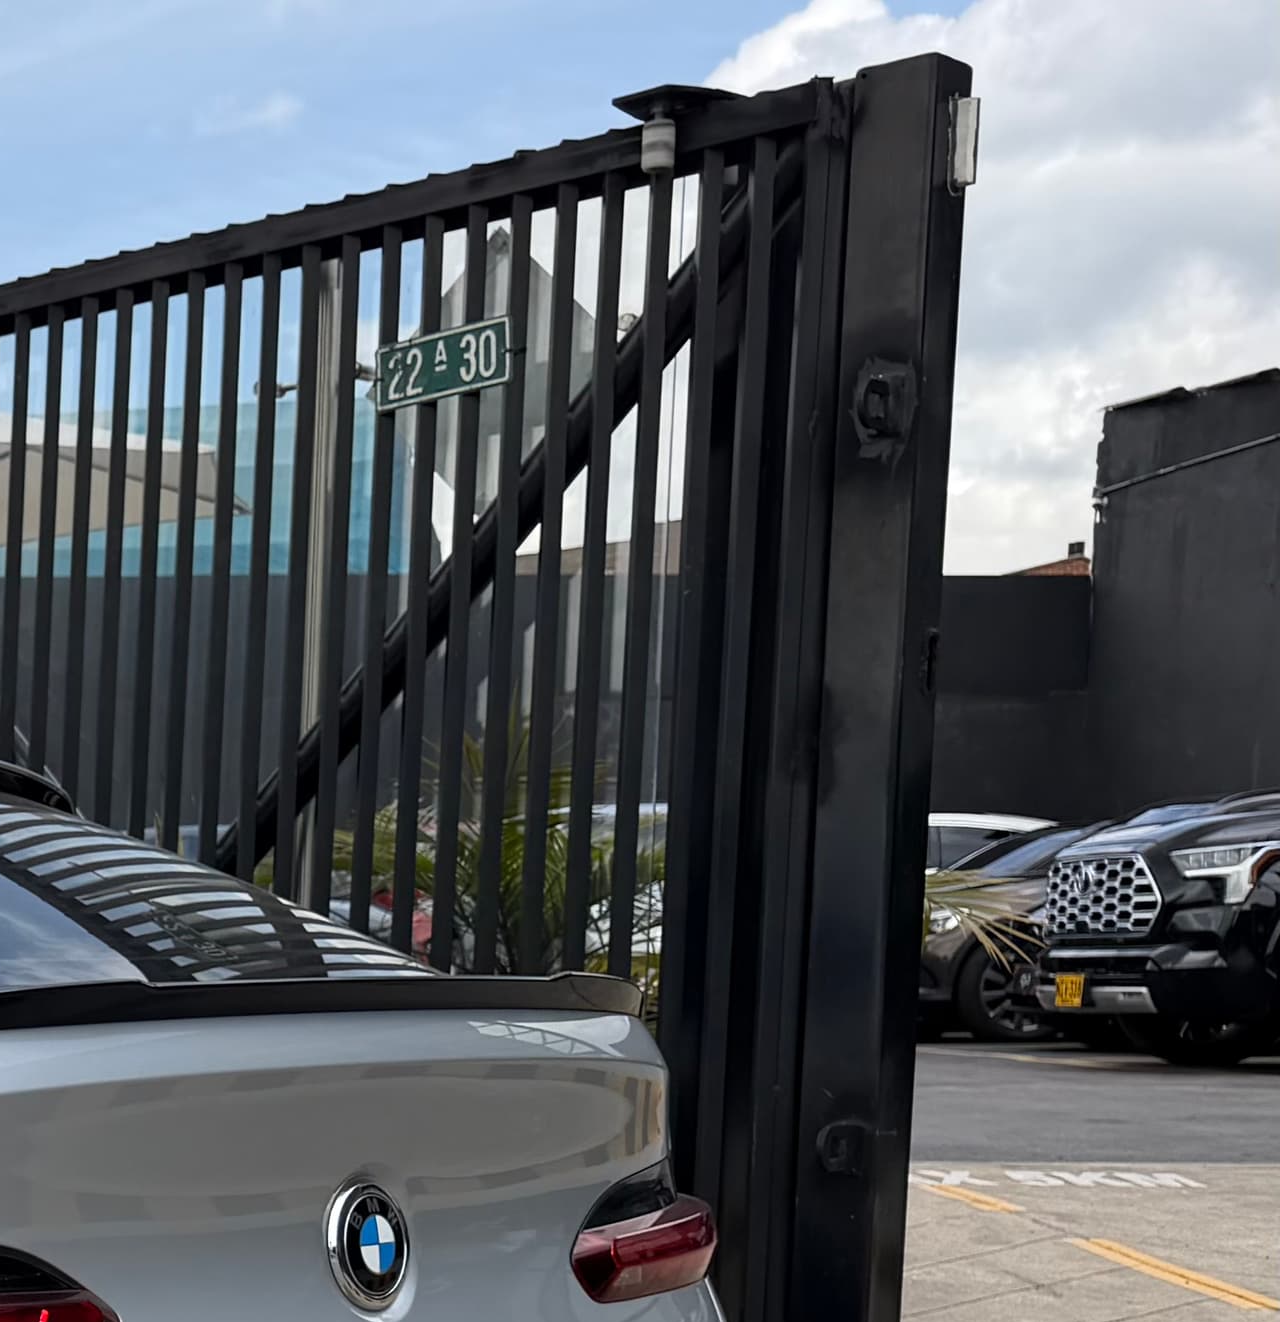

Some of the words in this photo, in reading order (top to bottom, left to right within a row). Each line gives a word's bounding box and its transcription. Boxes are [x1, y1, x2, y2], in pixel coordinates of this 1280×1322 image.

[388, 348, 423, 400] 22
[459, 330, 497, 382] 30
[351, 1198, 399, 1231] BMW
